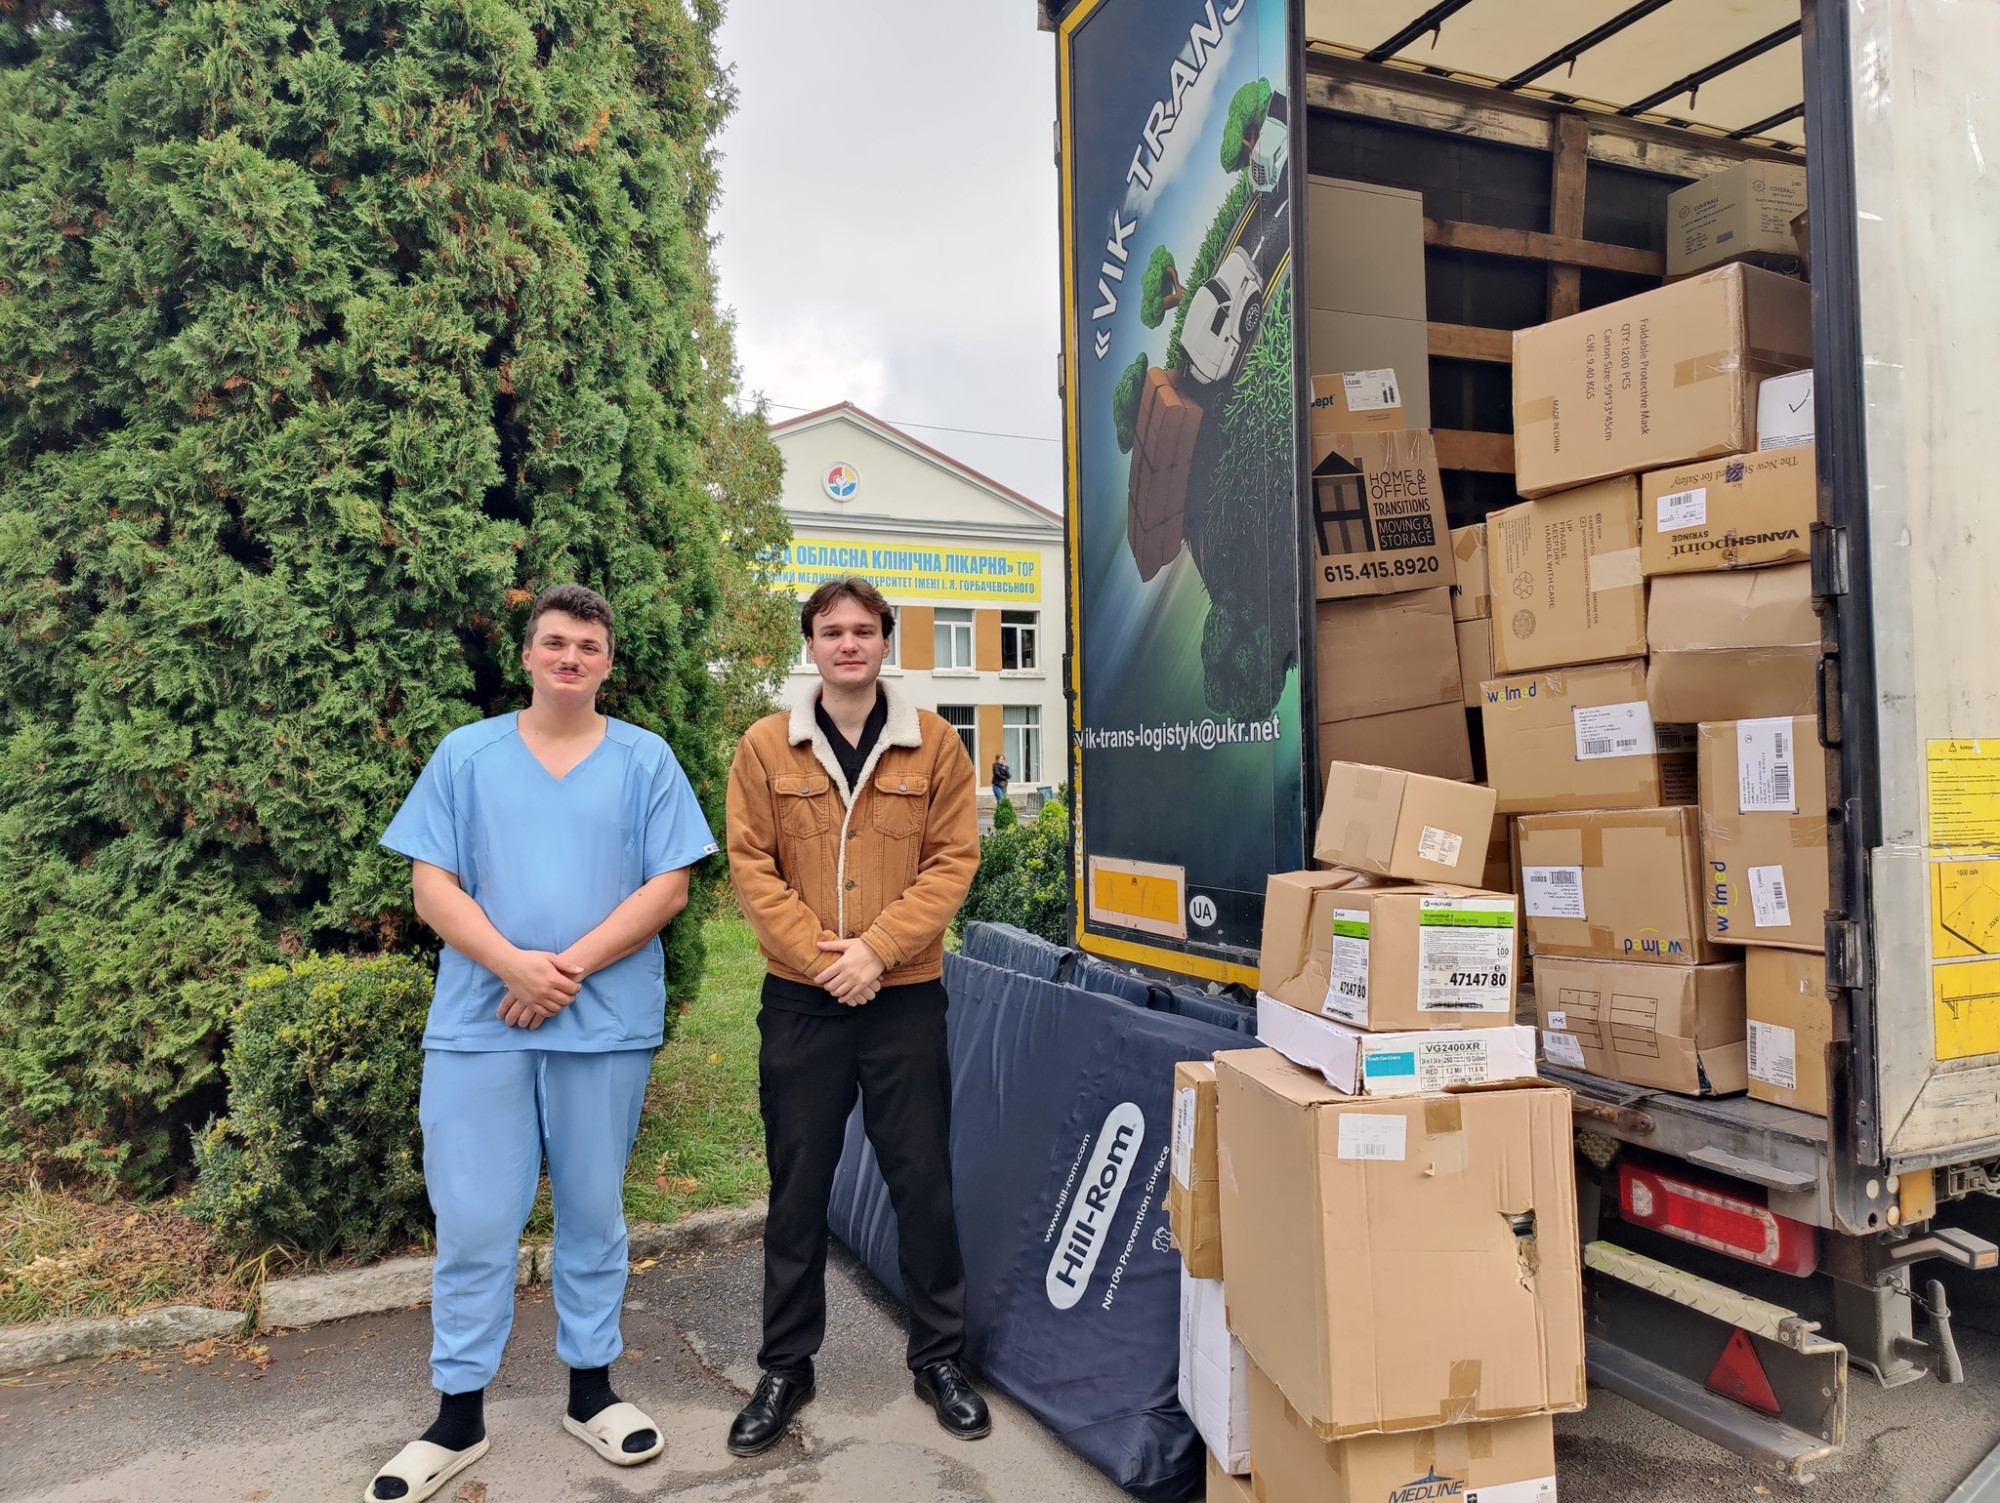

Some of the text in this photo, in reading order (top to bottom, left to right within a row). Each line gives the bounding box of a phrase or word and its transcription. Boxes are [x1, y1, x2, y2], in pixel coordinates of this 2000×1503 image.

[1603, 328, 1612, 360] Carton
[1621, 371, 1631, 390] PCS
[1640, 318, 1650, 435] Foldable Protective Mask
[1586, 381, 1595, 400] KGS
[1553, 422, 1560, 430] IN
[1756, 459, 1778, 471] New
[1780, 456, 1798, 467] The
[1369, 469, 1426, 485] HOME &
[1701, 469, 1713, 482] for
[1371, 482, 1428, 499] OFFICE
[1373, 498, 1430, 516] TRANSITIONS
[1379, 517, 1431, 534] MOVING &
[1552, 523, 1560, 547] KEEP
[1566, 520, 1573, 532] UP
[1380, 530, 1433, 548] STORAGE
[1545, 525, 1553, 560] HANDLE
[1559, 522, 1568, 559] FRAGILE
[1672, 530, 1709, 542] SYRINGE
[796, 545, 868, 568] ОБЛАСНА
[872, 550, 942, 572] КЛІНІЧНА
[945, 554, 1013, 576] ЛІКАРНЯ»
[1016, 561, 1034, 577] ТОР
[1324, 555, 1439, 583] 615.415.8920
[915, 578, 939, 590] ІМЕНІ
[960, 580, 1035, 594] ГОРБАЧЕВСЬКОГО
[1548, 585, 1556, 609] CARE
[1487, 680, 1536, 703] welmed
[1075, 713, 1280, 751] vik-trans-logistyk@ukr.net
[1710, 861, 1729, 932] welmed
[1193, 902, 1212, 921] UA
[1496, 948, 1509, 956] 100
[1624, 938, 1682, 957] welmed
[1449, 973, 1506, 986] 47147 80
[1340, 981, 1366, 999] 47147 80
[1426, 1042, 1480, 1052] VG2400XR
[1044, 1133, 1091, 1243] www.hill-rom.com
[1055, 1123, 1135, 1289] Hill-Rom
[1102, 1145, 1170, 1311] NP100 Prevention Surface
[1388, 1480, 1465, 1503] MEDLINE
